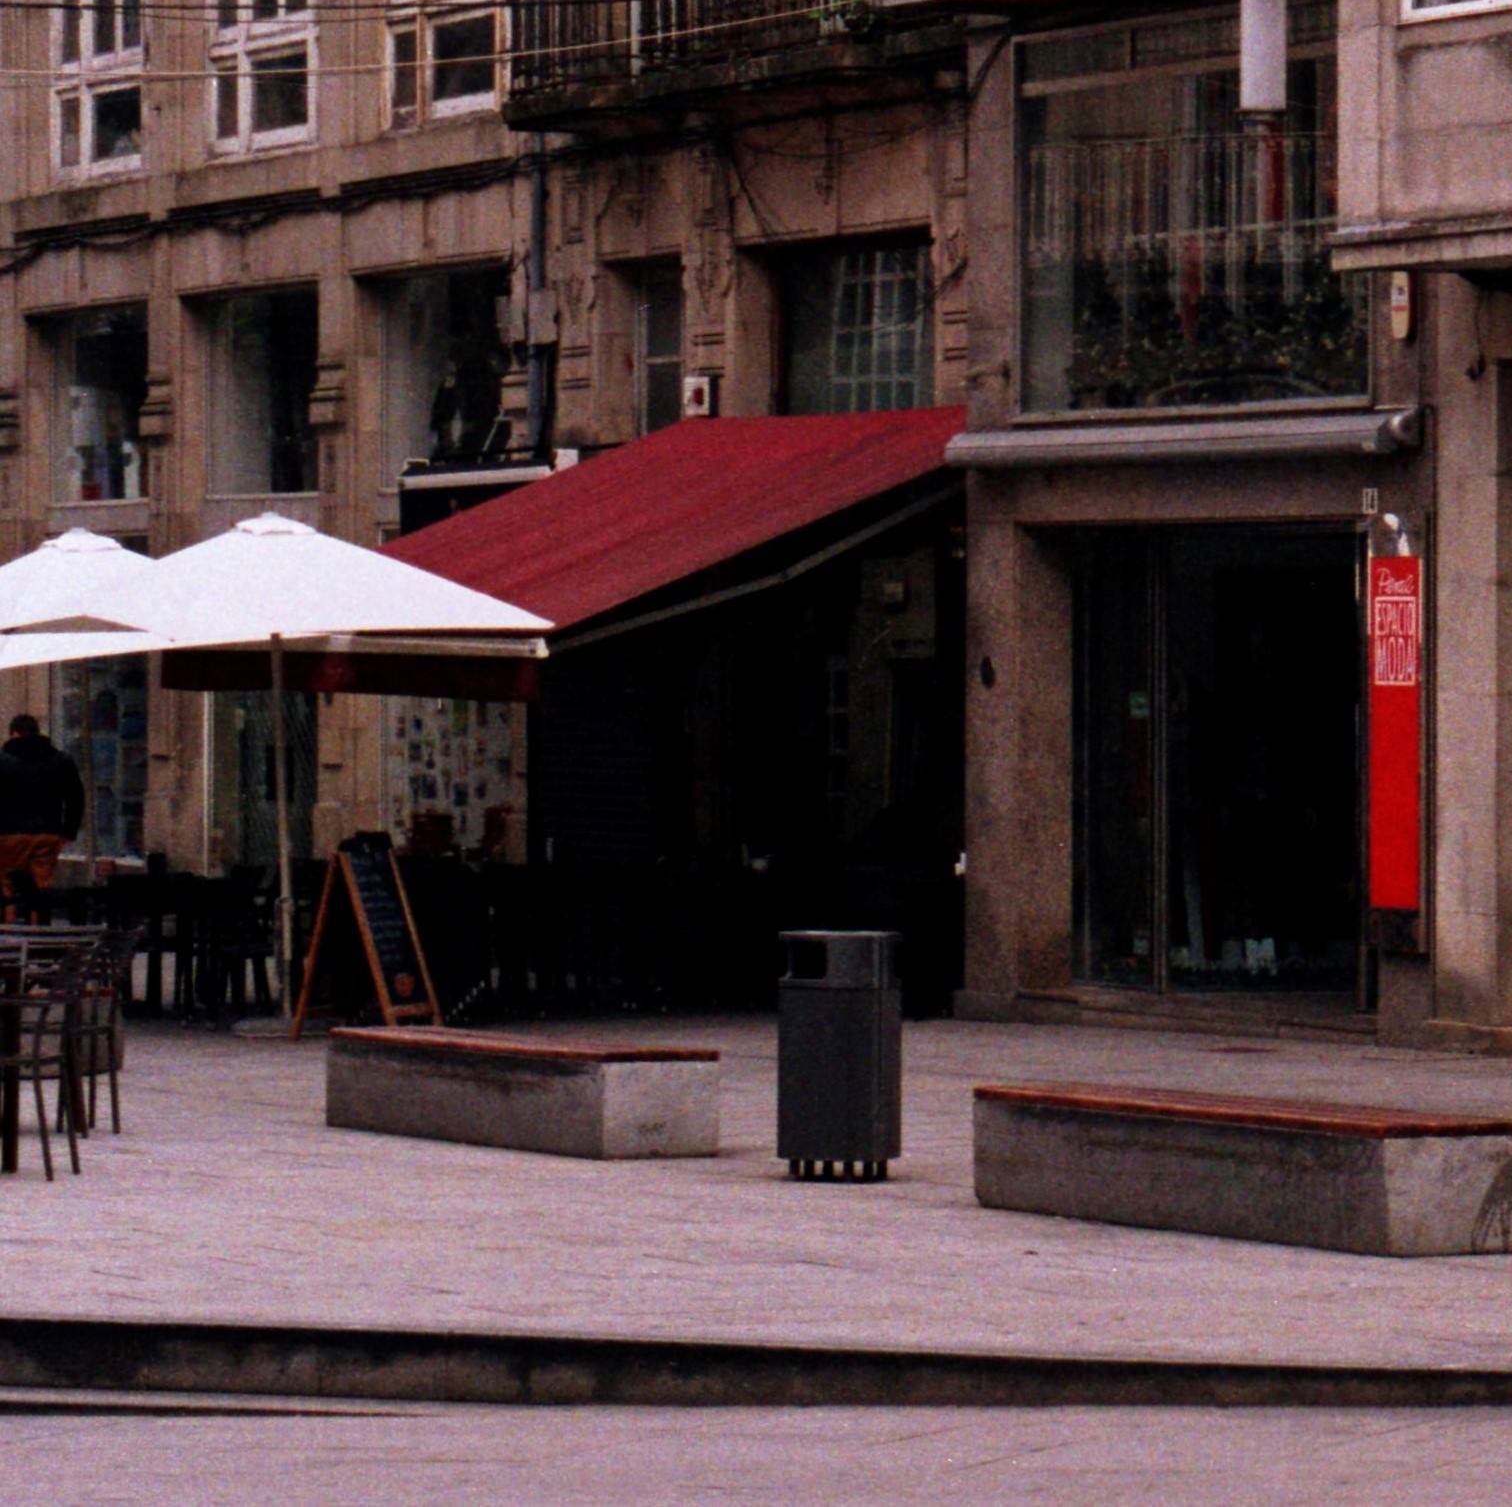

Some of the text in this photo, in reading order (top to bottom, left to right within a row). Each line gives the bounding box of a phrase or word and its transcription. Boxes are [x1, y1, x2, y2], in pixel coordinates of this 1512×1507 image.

[1376, 567, 1415, 595] Peral
[1377, 603, 1415, 636] ESPACIO
[1377, 636, 1415, 683] MODA
